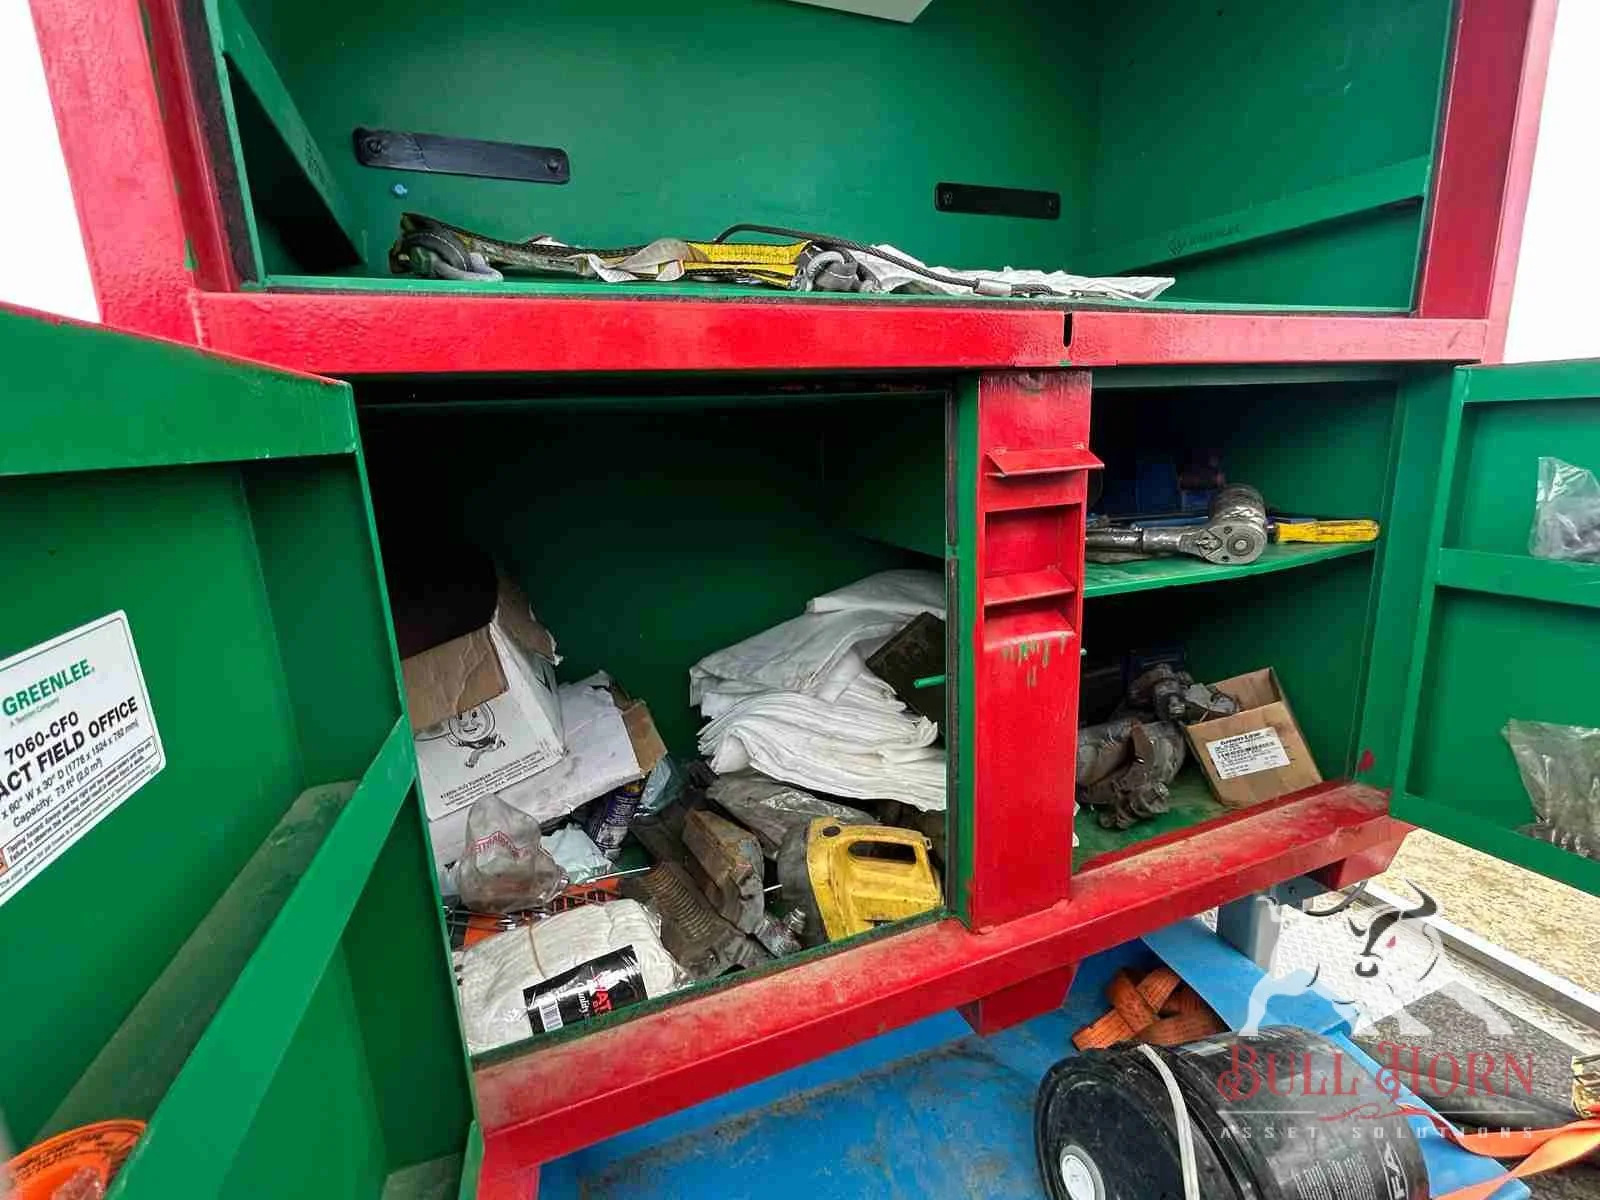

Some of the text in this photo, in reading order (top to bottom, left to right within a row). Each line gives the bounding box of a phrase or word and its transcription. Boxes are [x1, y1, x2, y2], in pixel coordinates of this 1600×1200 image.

[4, 712, 78, 765] 7060-CFO
[36, 730, 85, 774] FIELD
[88, 696, 138, 738] OFFICE
[13, 798, 54, 828] Capacity:
[55, 784, 66, 798] 73
[25, 788, 34, 801] W
